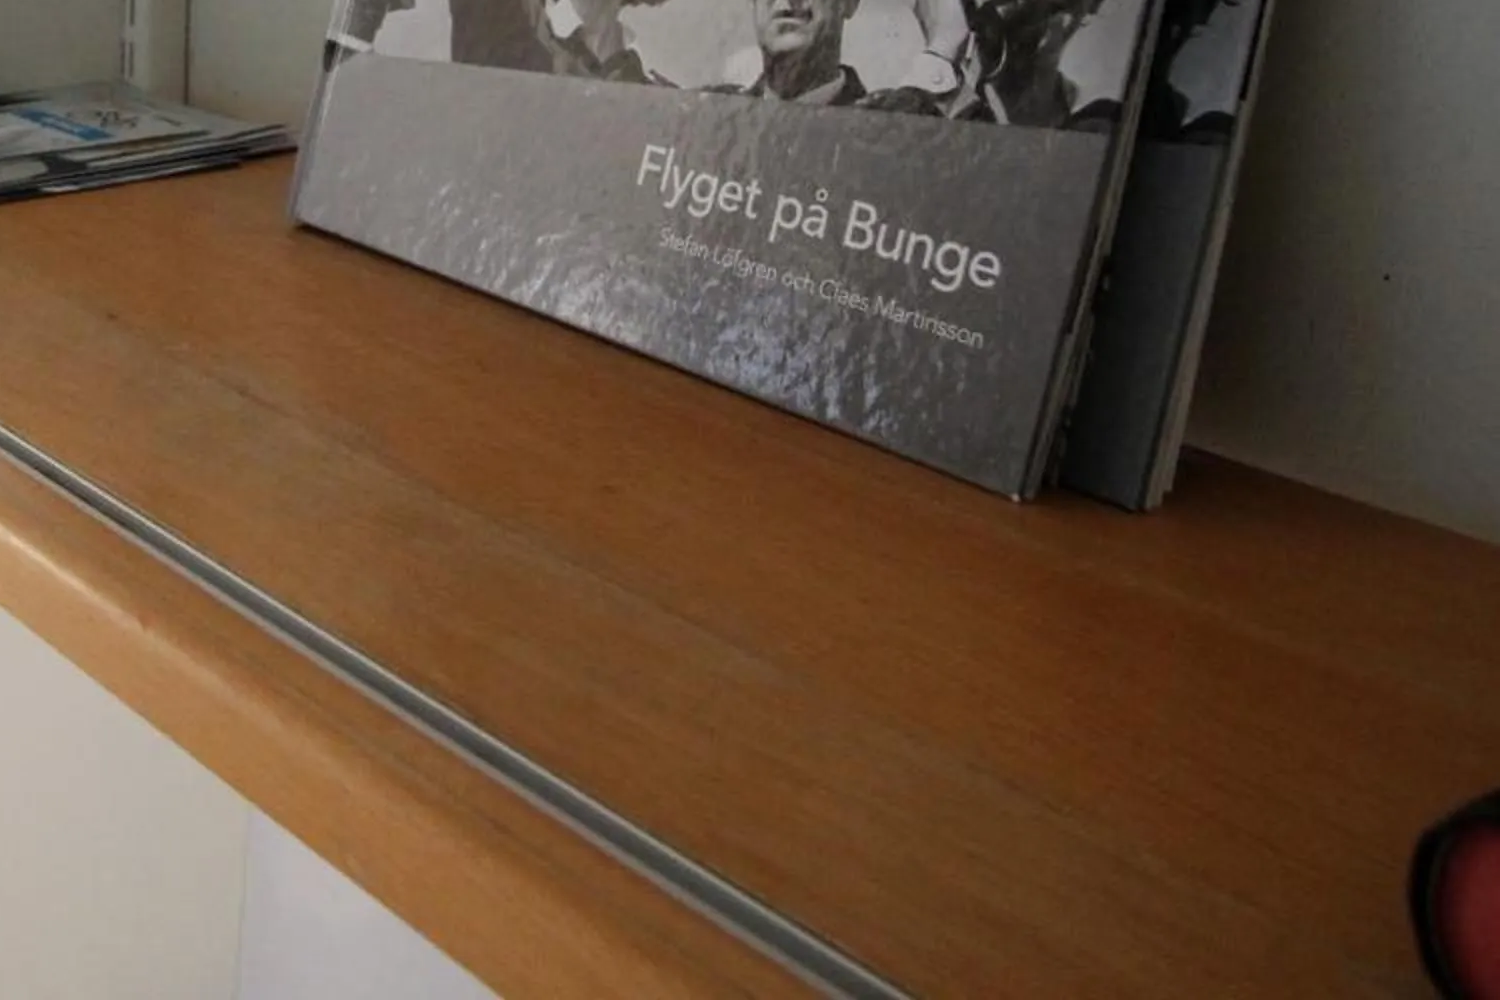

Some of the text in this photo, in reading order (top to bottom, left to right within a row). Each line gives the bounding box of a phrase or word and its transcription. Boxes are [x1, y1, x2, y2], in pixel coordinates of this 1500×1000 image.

[636, 143, 1002, 293] Flyget på Bunge
[659, 226, 709, 261] Stefan
[781, 268, 815, 296] och
[819, 277, 869, 312] Claes
[873, 295, 984, 350] Martinsson
